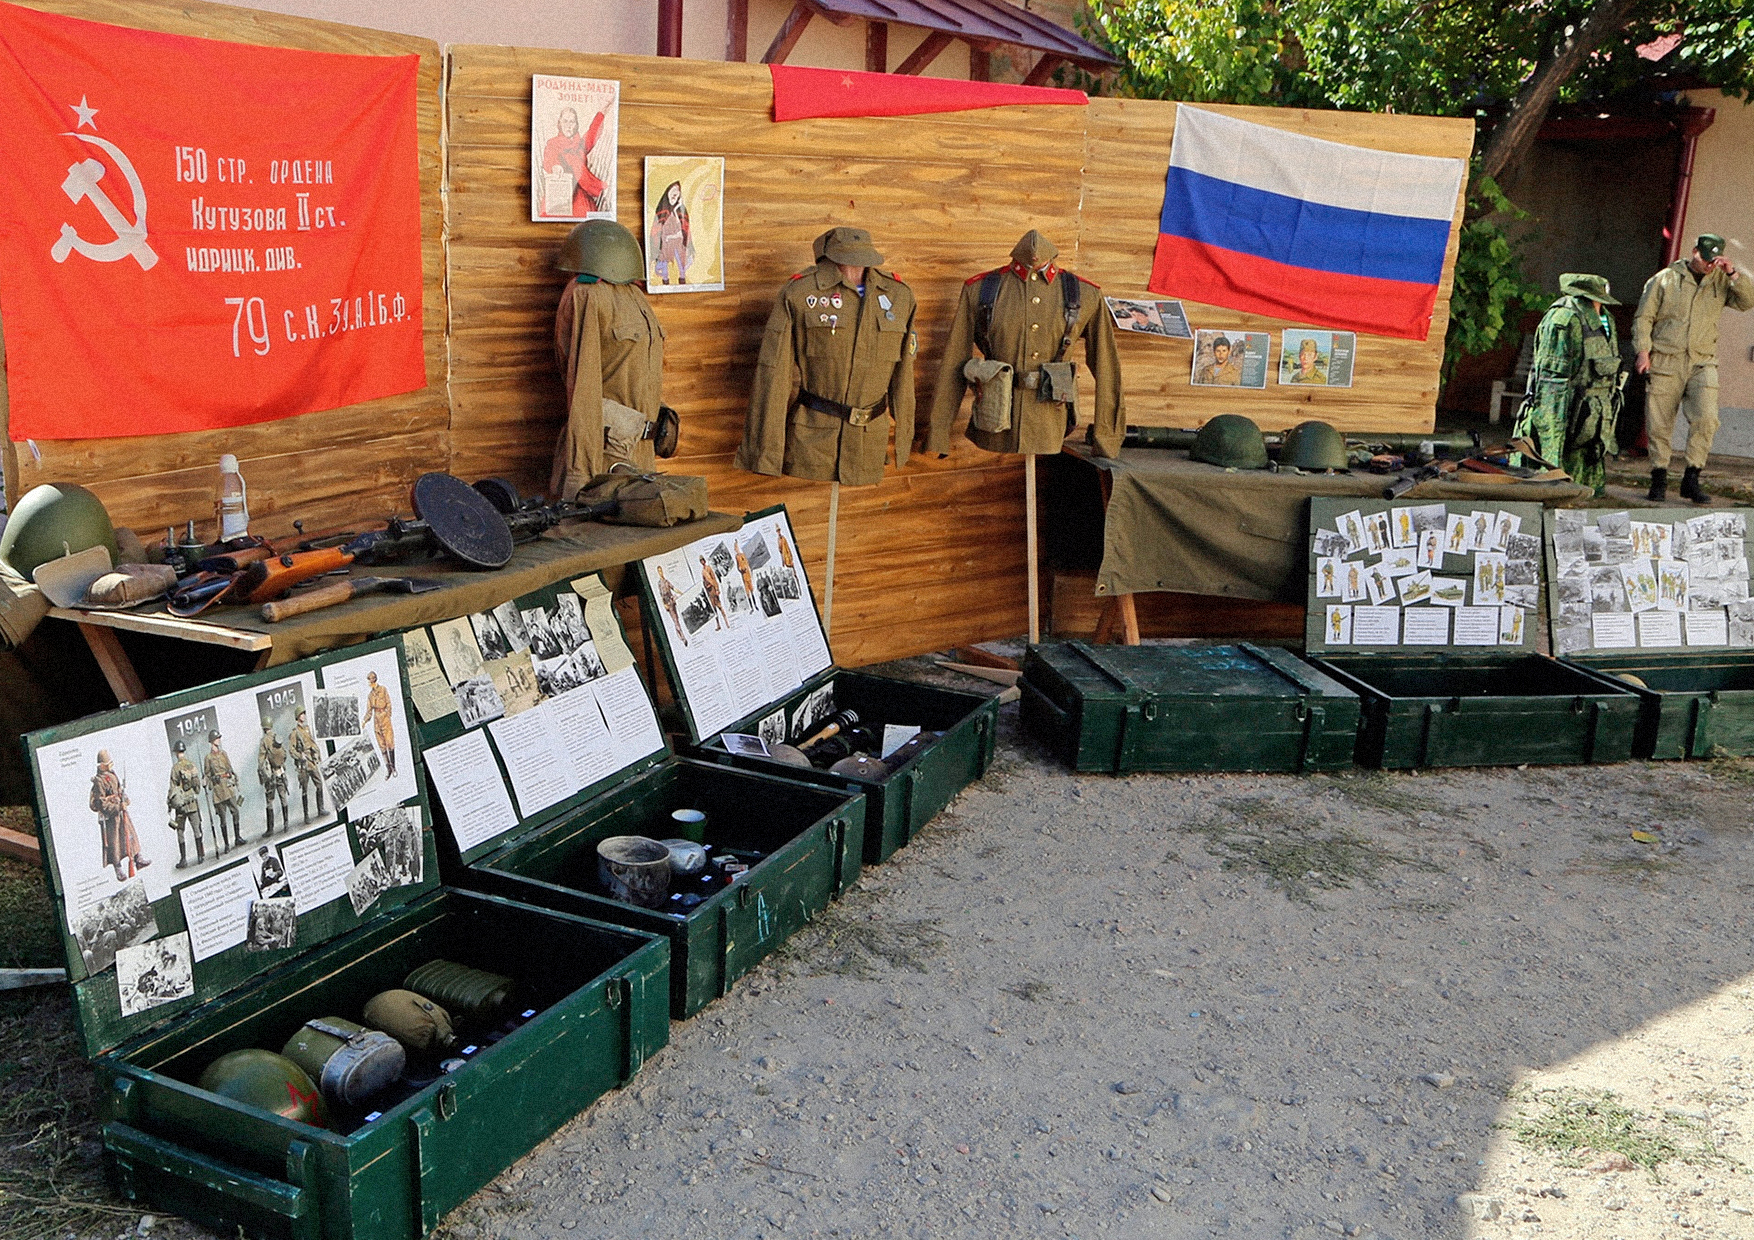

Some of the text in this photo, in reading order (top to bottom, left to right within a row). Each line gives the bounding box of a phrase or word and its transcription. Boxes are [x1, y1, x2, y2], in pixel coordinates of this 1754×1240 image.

[537, 79, 616, 94] РОДИНА-МАТЬ
[175, 146, 208, 183] 150
[224, 296, 270, 358] 79
[267, 688, 297, 710] 1945
[176, 714, 208, 737] 1941
